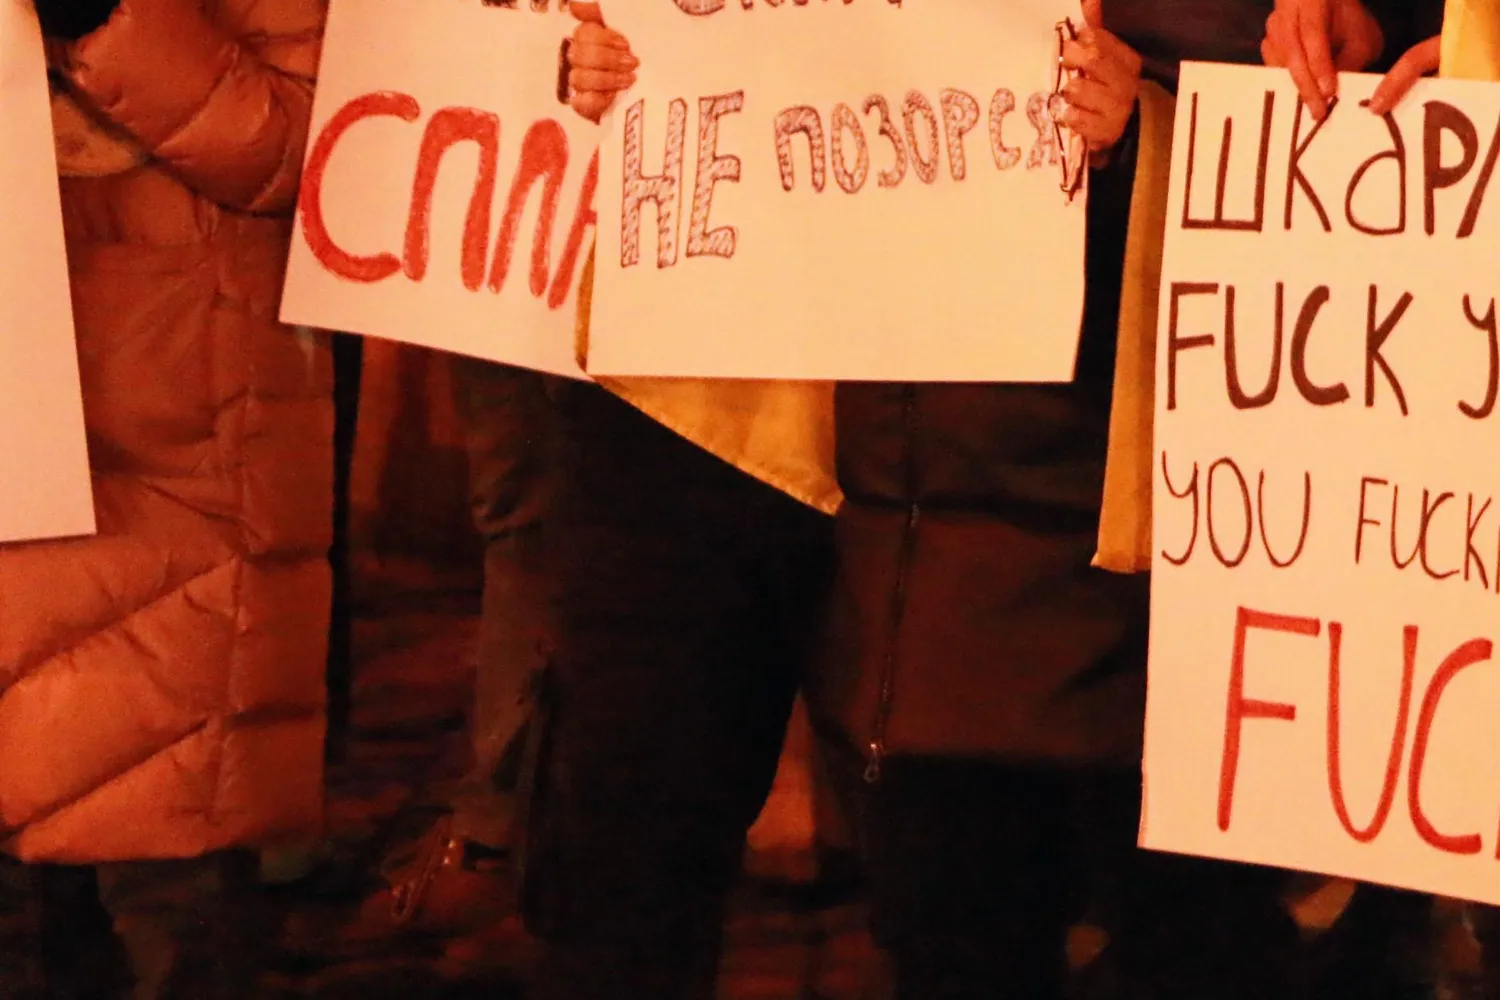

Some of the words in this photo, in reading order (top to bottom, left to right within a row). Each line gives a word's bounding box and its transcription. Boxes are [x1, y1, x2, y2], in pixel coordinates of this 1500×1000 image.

[620, 90, 744, 268] НЕ
[773, 87, 1062, 194] ПОЗОРСЯ
[1166, 282, 1413, 417] FUCK
[1161, 450, 1311, 568] YOU
